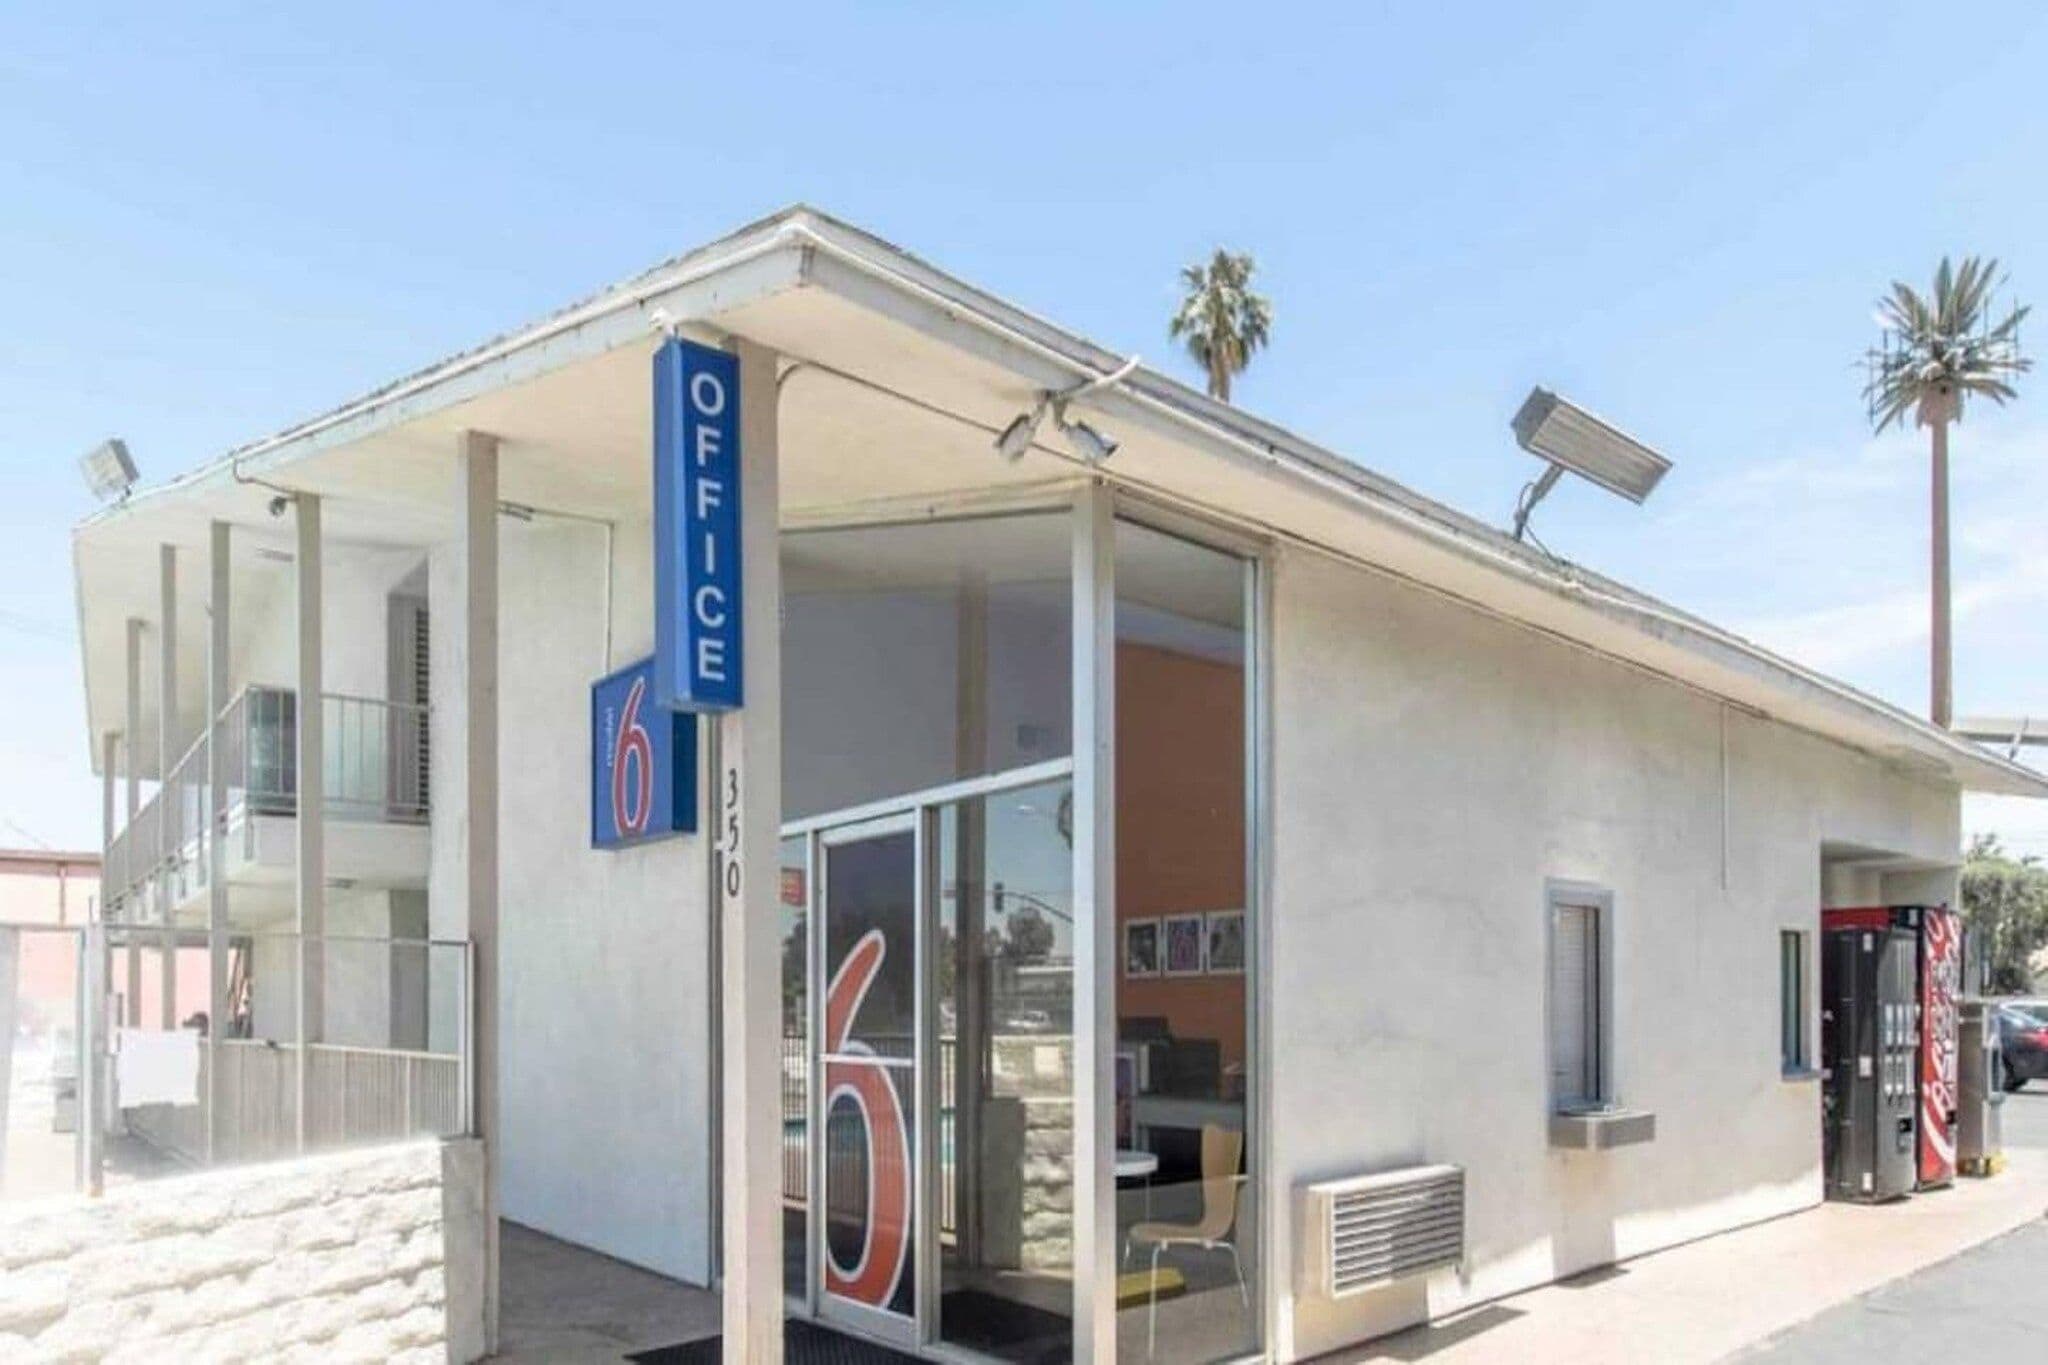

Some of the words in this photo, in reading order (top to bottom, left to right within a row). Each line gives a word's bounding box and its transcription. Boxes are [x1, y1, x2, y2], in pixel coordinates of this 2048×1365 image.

[690, 372, 726, 681] OFFICE
[613, 675, 653, 838] 6
[727, 767, 739, 898] 350
[826, 928, 911, 1310] 6
